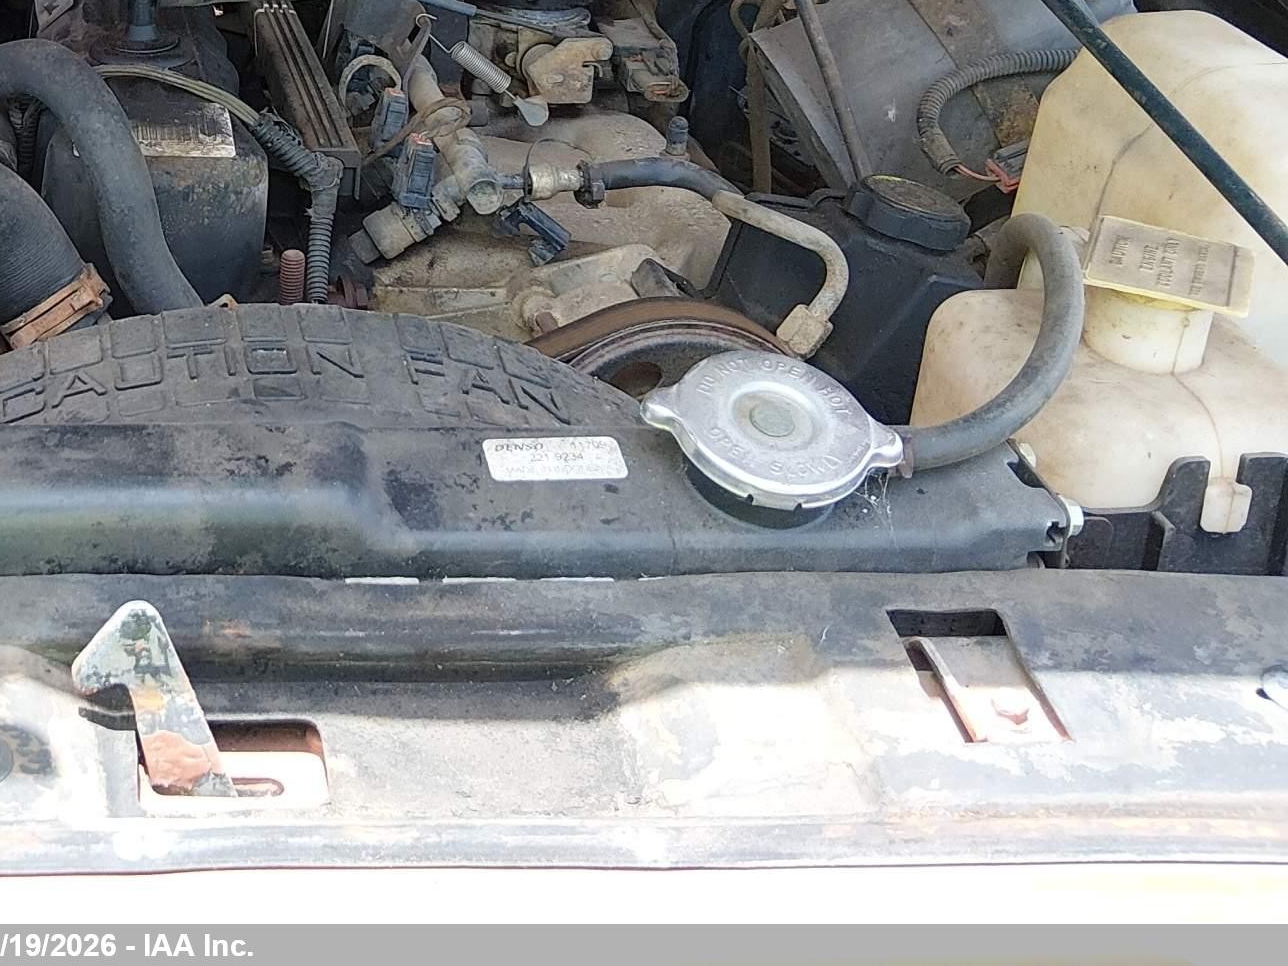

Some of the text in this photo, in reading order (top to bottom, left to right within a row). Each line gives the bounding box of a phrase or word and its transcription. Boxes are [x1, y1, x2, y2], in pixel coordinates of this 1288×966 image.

[403, 352, 573, 425] FAN
[714, 358, 751, 378] NOT
[760, 358, 817, 387] OPEN
[817, 385, 853, 416] HOT
[494, 442, 544, 452] DENSO
